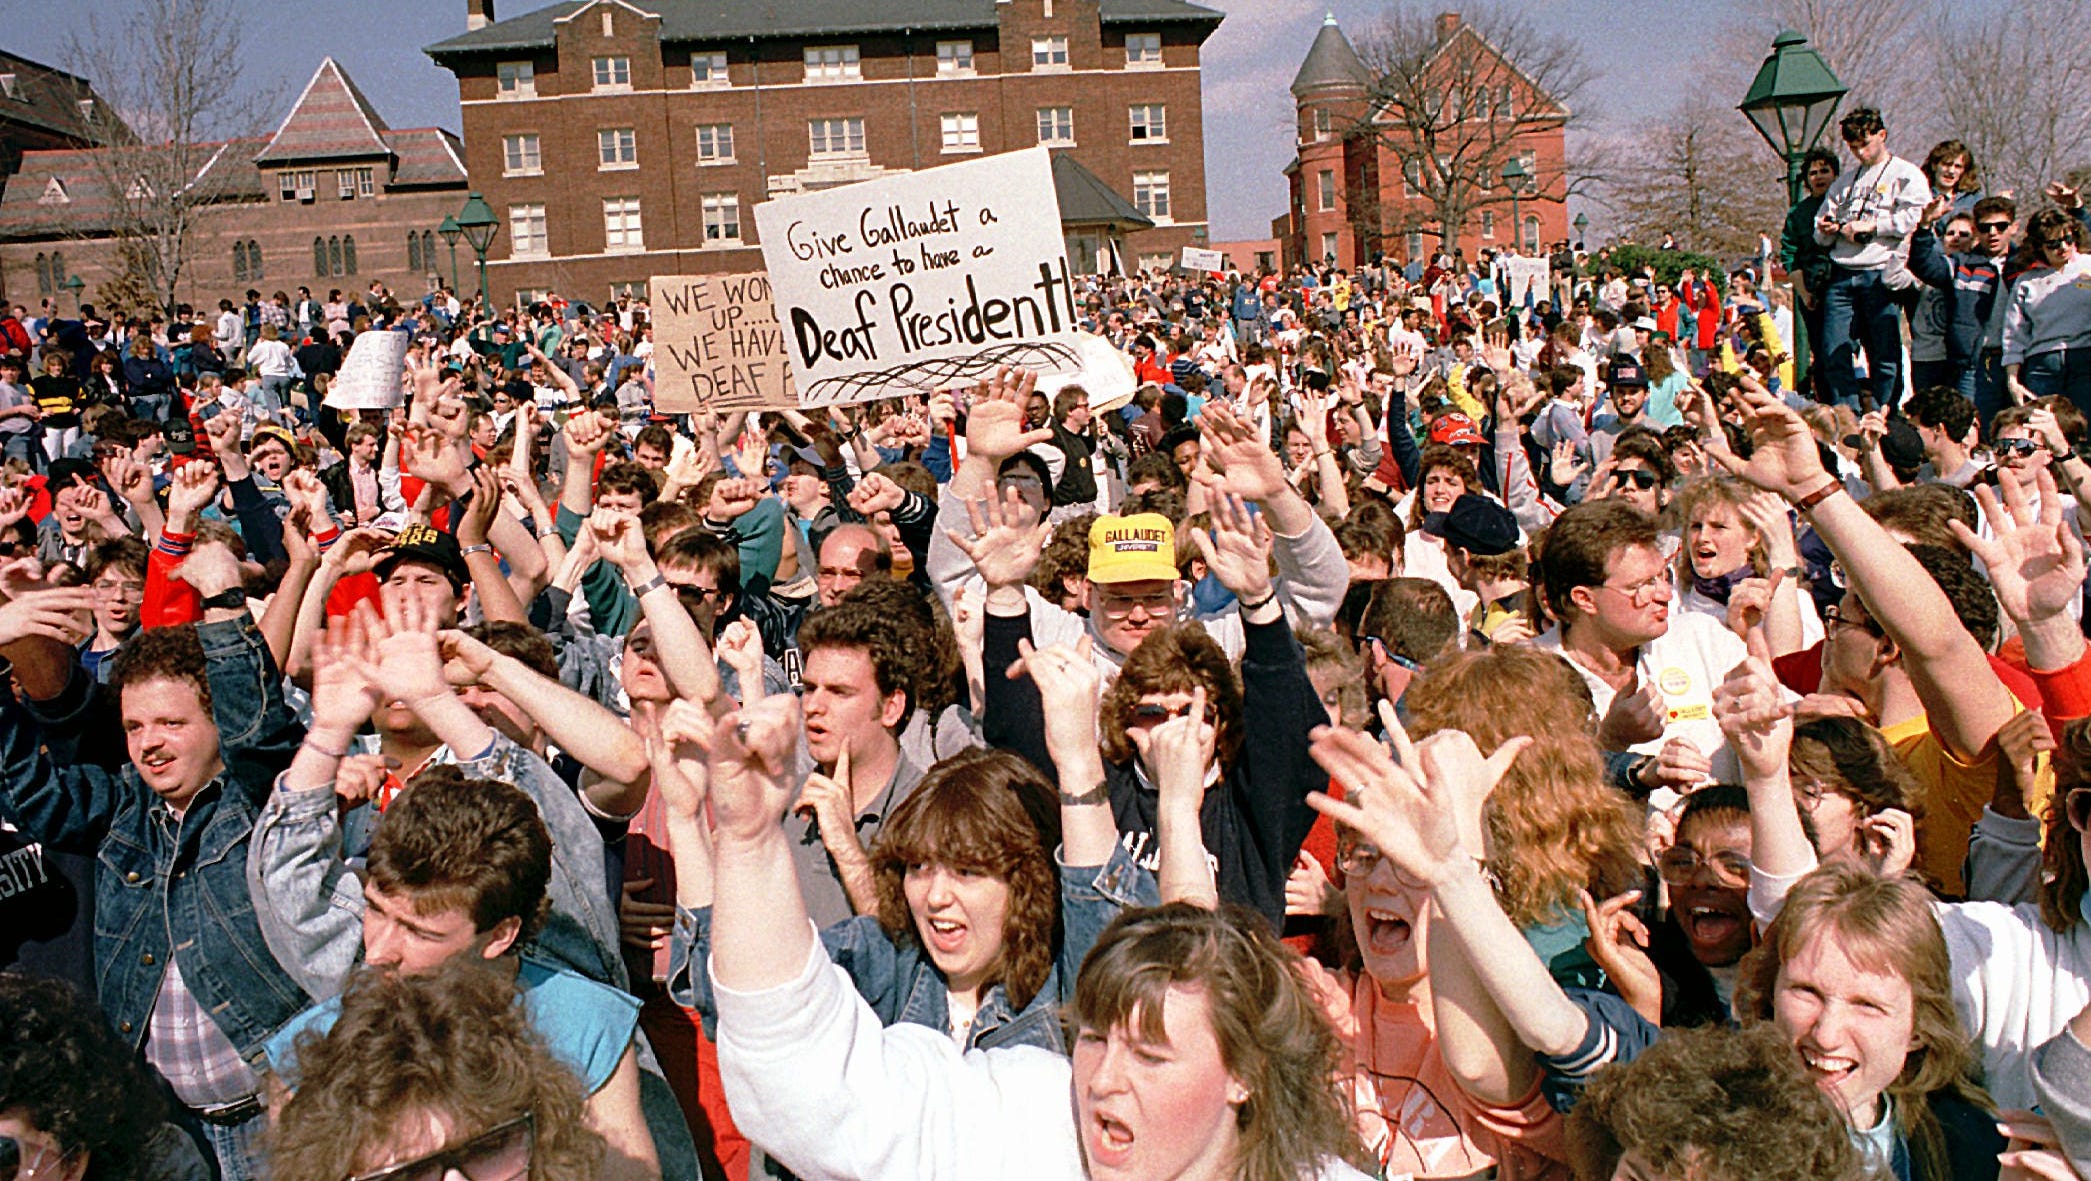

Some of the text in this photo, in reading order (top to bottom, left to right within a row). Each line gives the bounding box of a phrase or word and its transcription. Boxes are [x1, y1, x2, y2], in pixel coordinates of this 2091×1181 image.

[787, 199, 998, 261] Give Gallaudet a
[820, 242, 994, 289] chance to have a
[661, 282, 716, 316] WE
[790, 256, 1079, 370] Deaf President!
[667, 331, 719, 371] WE
[691, 362, 766, 403] DEAF
[1105, 528, 1166, 544] GALLAUDET
